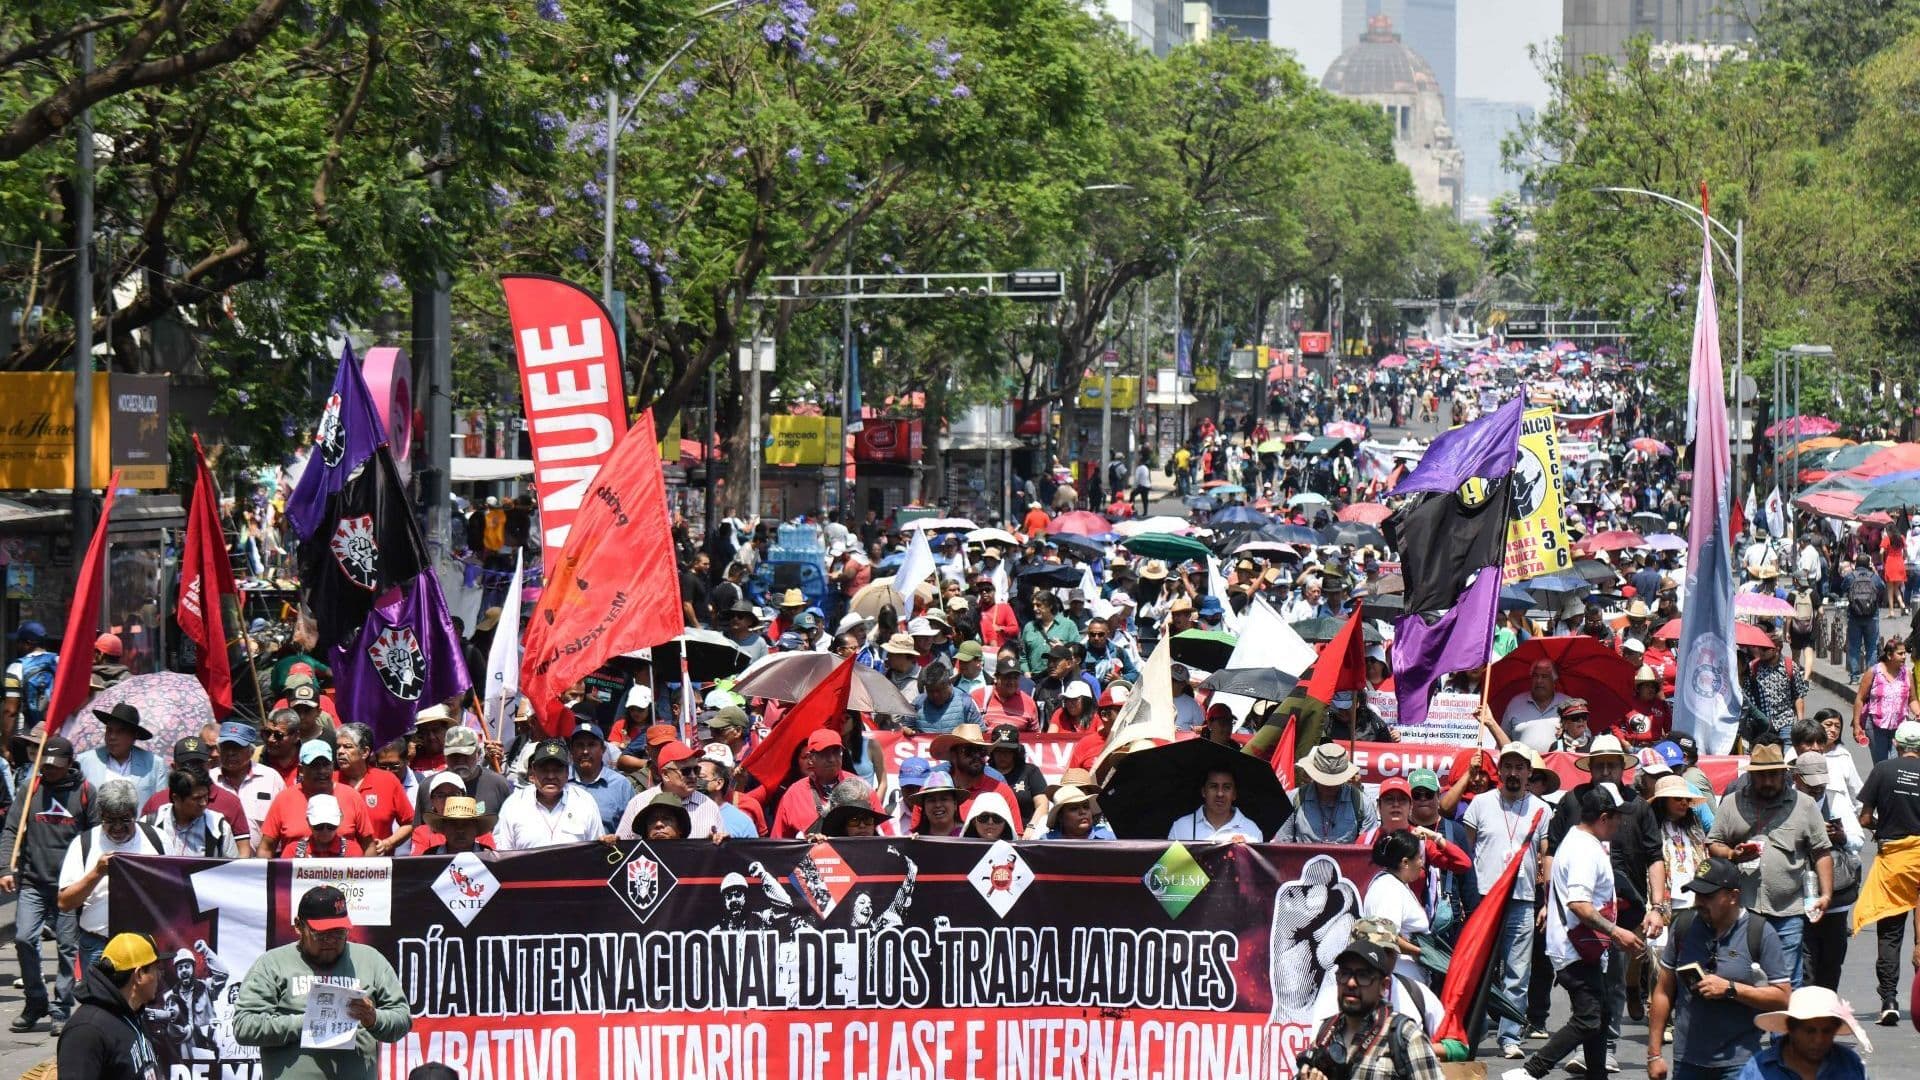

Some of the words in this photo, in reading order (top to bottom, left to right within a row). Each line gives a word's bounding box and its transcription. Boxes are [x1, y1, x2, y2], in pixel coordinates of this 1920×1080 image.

[778, 431, 818, 440] mercado
[777, 440, 801, 449] pago
[1418, 732, 1428, 740] Ley
[296, 866, 343, 880] Asamblea
[346, 866, 389, 880] Nacional
[449, 900, 484, 910] CNTE
[399, 925, 469, 1018] DÍA
[477, 930, 788, 1015] INTERNACIONAL
[799, 929, 849, 1009] DE
[856, 928, 931, 1009] LOS
[936, 927, 1238, 1011] TRABAJADORES
[789, 1022, 832, 1080] DE
